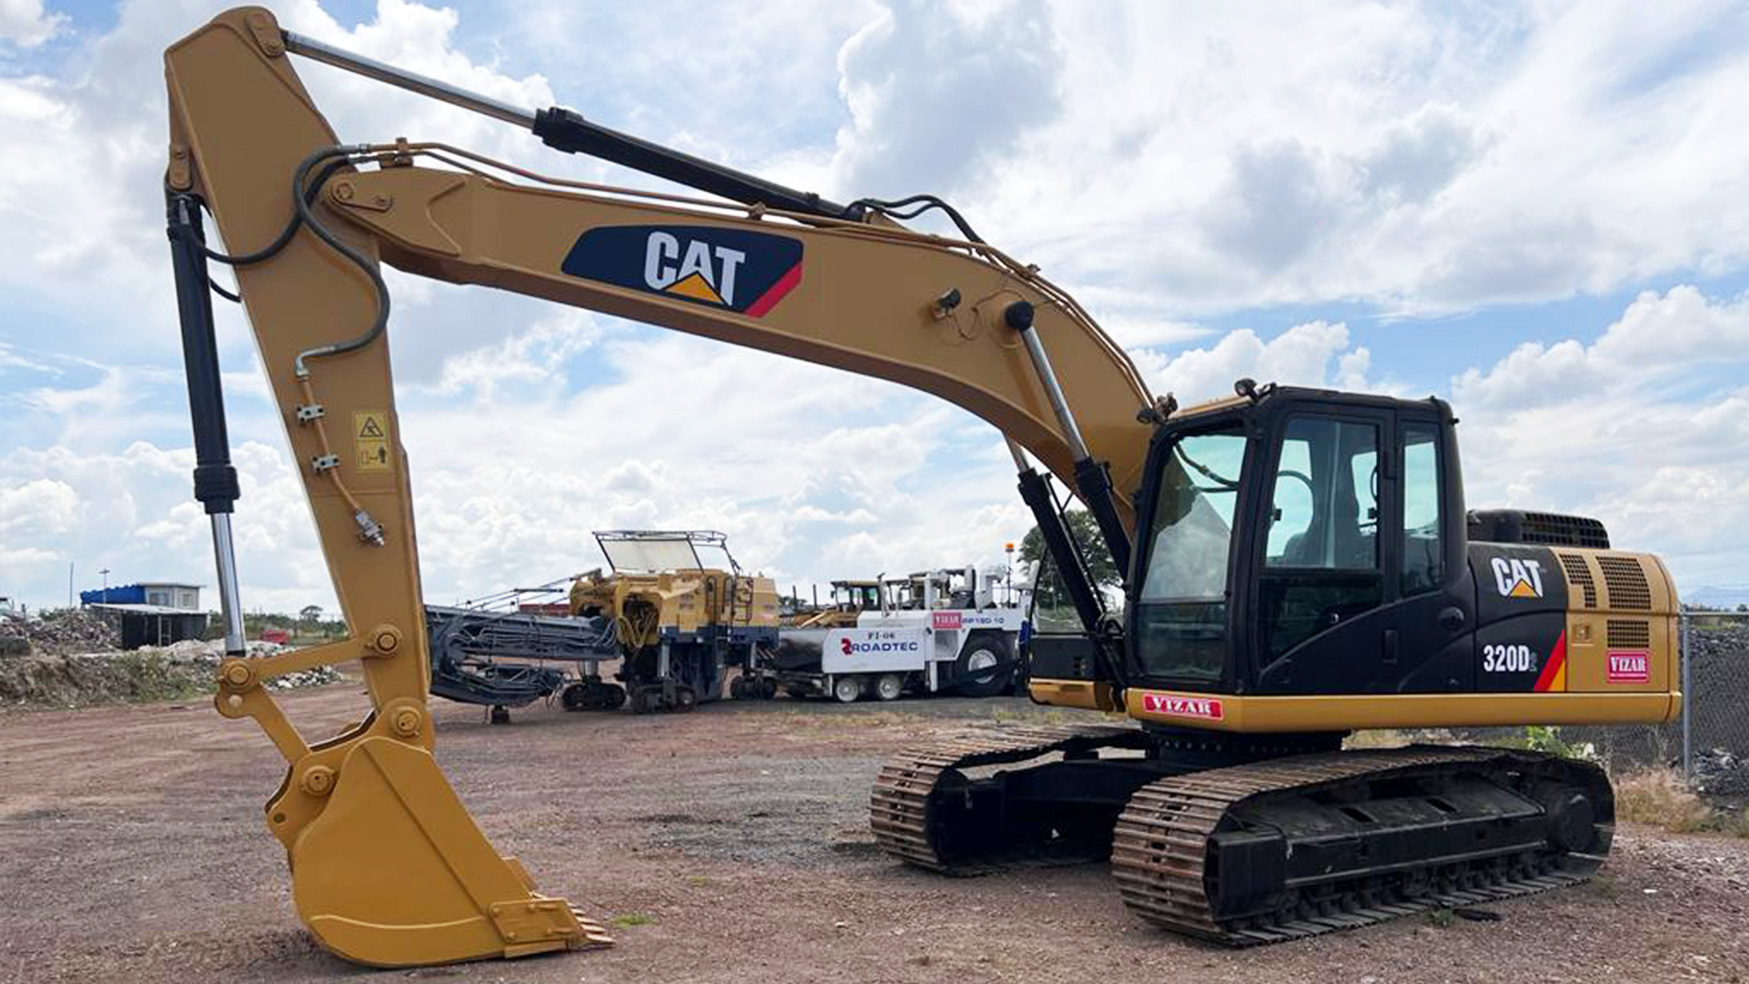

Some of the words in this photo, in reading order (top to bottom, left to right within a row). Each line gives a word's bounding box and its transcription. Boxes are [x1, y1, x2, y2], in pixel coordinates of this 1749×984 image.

[645, 231, 745, 306] CAT
[1491, 557, 1543, 598] CAT
[851, 641, 919, 653] ROADTEC
[1611, 656, 1646, 672] VIZAR
[1152, 695, 1211, 715] VIZAR
